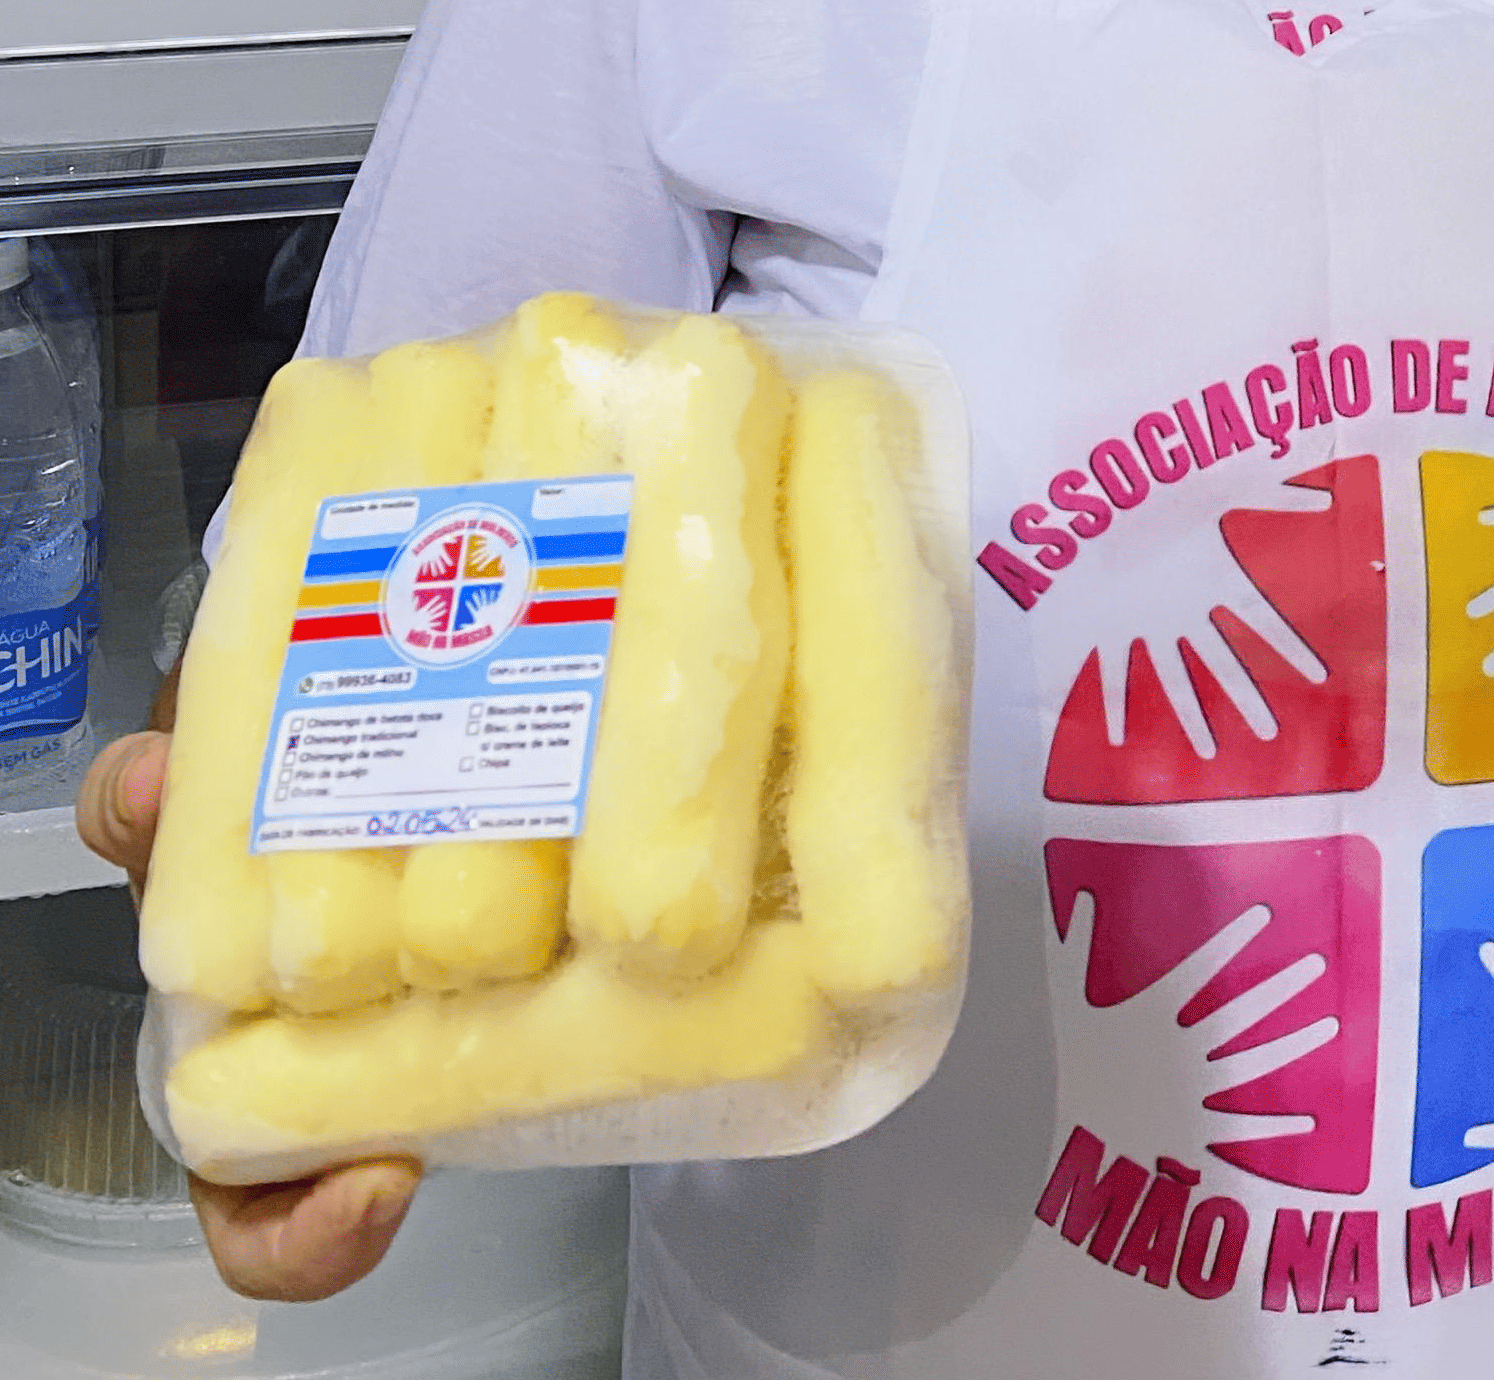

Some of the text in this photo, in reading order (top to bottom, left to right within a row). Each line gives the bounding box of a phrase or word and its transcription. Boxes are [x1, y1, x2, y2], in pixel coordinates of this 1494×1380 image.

[976, 338, 1372, 612] ASSOCIAÇÃO
[1391, 338, 1469, 414] DE
[1035, 1124, 1246, 1302] MÃO
[1262, 1207, 1379, 1314] NA
